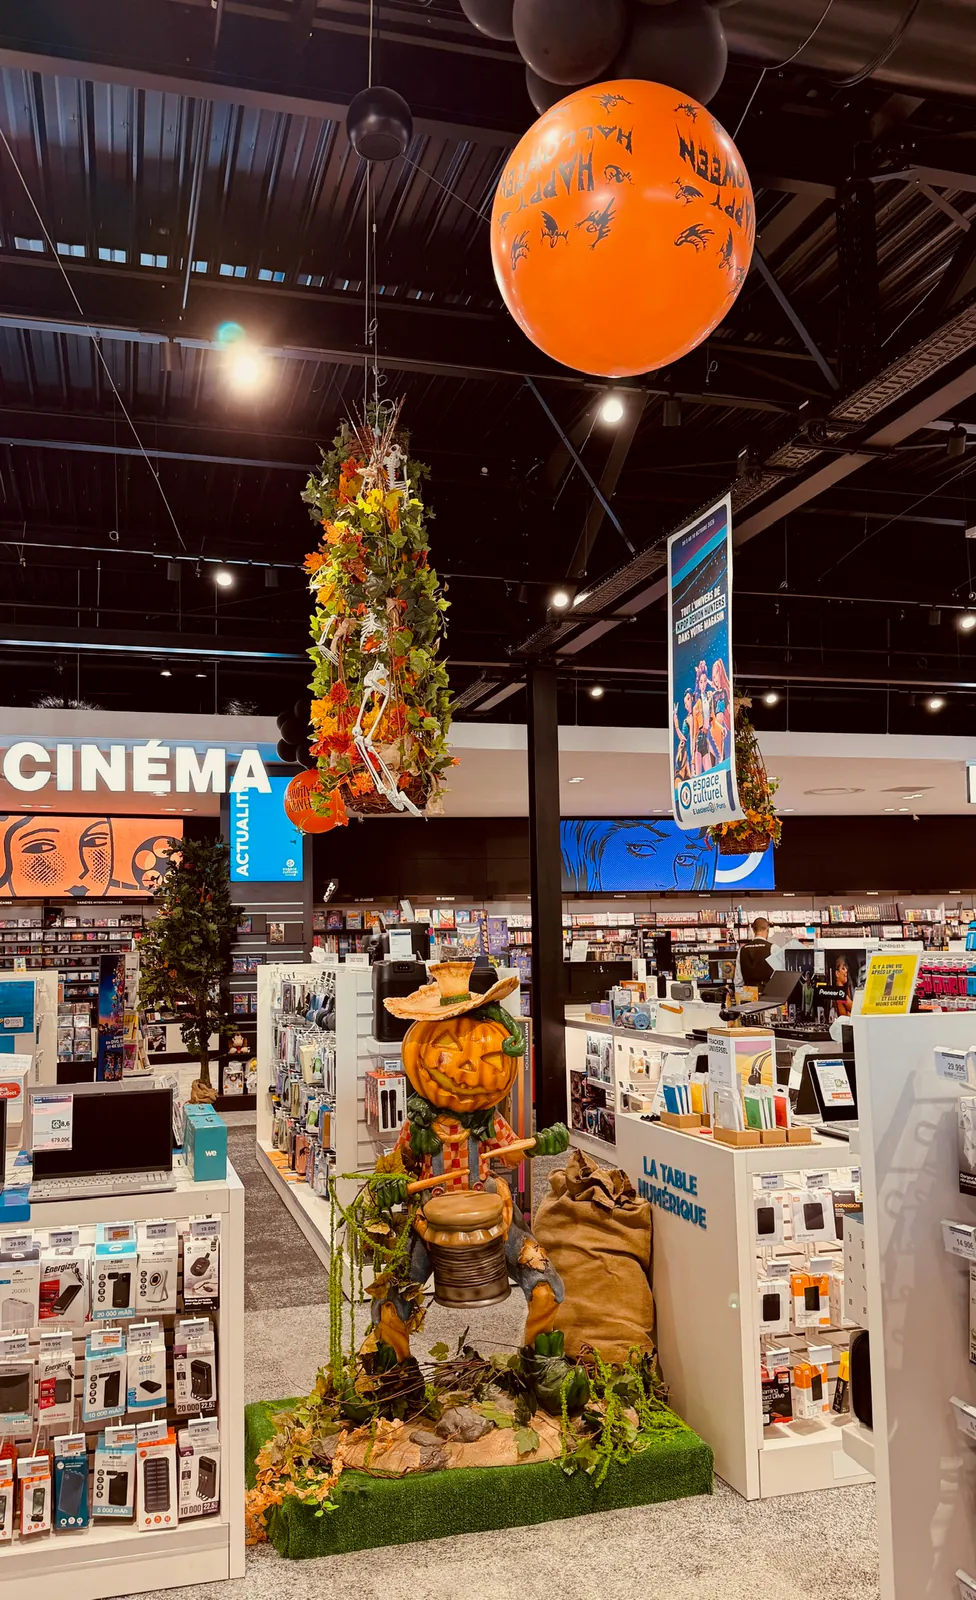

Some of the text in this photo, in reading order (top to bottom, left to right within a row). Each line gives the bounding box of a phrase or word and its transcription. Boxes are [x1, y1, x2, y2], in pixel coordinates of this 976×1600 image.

[517, 141, 595, 212] HAPPY
[714, 586, 721, 598] DE
[676, 596, 725, 632] KPOP DEMON HUNTERS
[678, 611, 724, 644] DANS VOTRE MAGASIN
[3, 740, 272, 793] CINÉMA
[693, 775, 719, 791] espace
[693, 784, 723, 804] culturel
[708, 1037, 724, 1046] TRACKER
[643, 1156, 698, 1196] LA TABLE
[638, 1178, 707, 1229] NUMÉRIQUE
[44, 1262, 78, 1274] Energizer
[44, 1360, 70, 1372] Energizer
[178, 1403, 200, 1412] 20 000
[181, 1504, 202, 1515] 10 000
